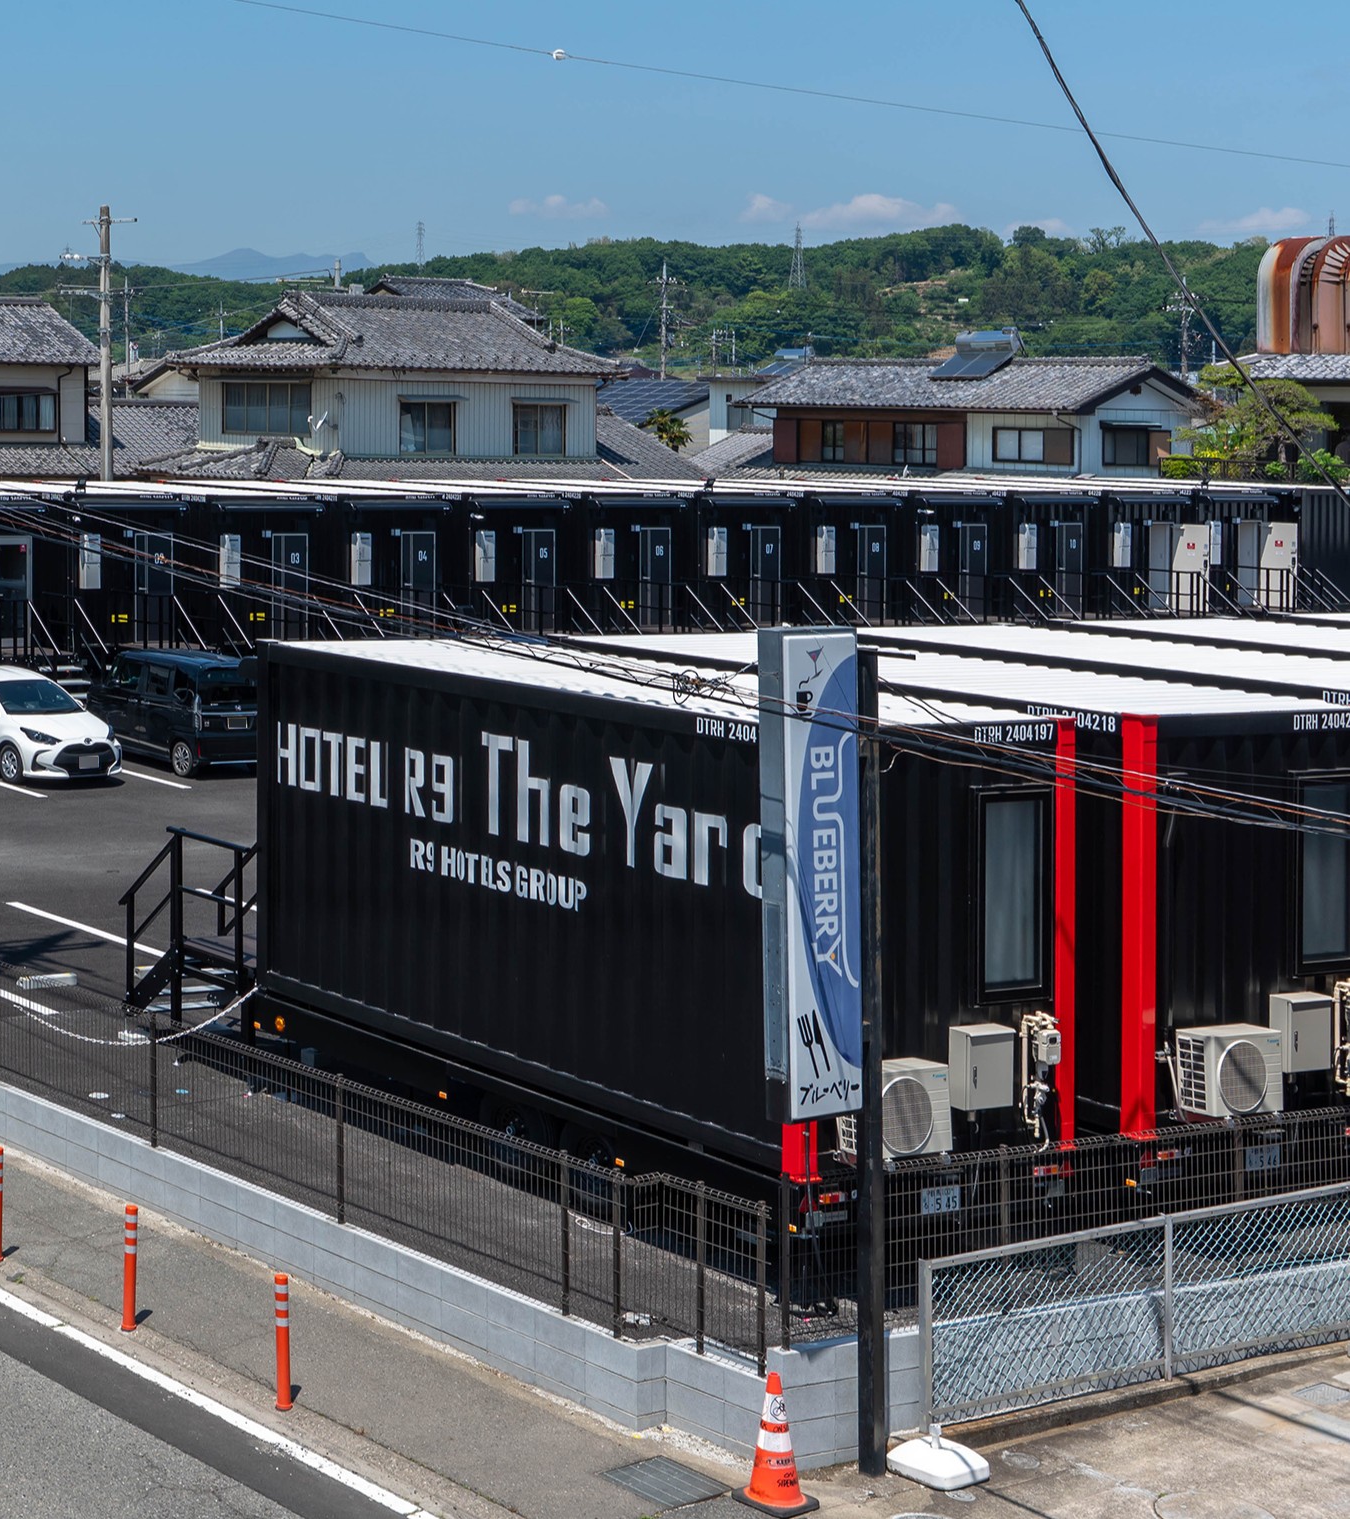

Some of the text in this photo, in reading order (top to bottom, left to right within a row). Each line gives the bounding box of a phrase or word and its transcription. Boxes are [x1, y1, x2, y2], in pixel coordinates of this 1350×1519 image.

[290, 552, 300, 564] 03
[418, 550, 428, 562] 04
[539, 547, 548, 559] 05
[655, 545, 664, 556] 06
[765, 544, 774, 555] 07
[696, 716, 757, 743] DTRH 2404
[1293, 713, 1319, 731] DTRH
[974, 723, 1054, 743] DTRH 2404197
[277, 720, 389, 809] HOTEL
[404, 746, 455, 824] R9
[481, 730, 591, 858] The
[809, 742, 846, 978] BLUEBERRY
[410, 837, 588, 912] R9 HOTELS GROUP
[799, 1077, 860, 1106] ブルーベリー
